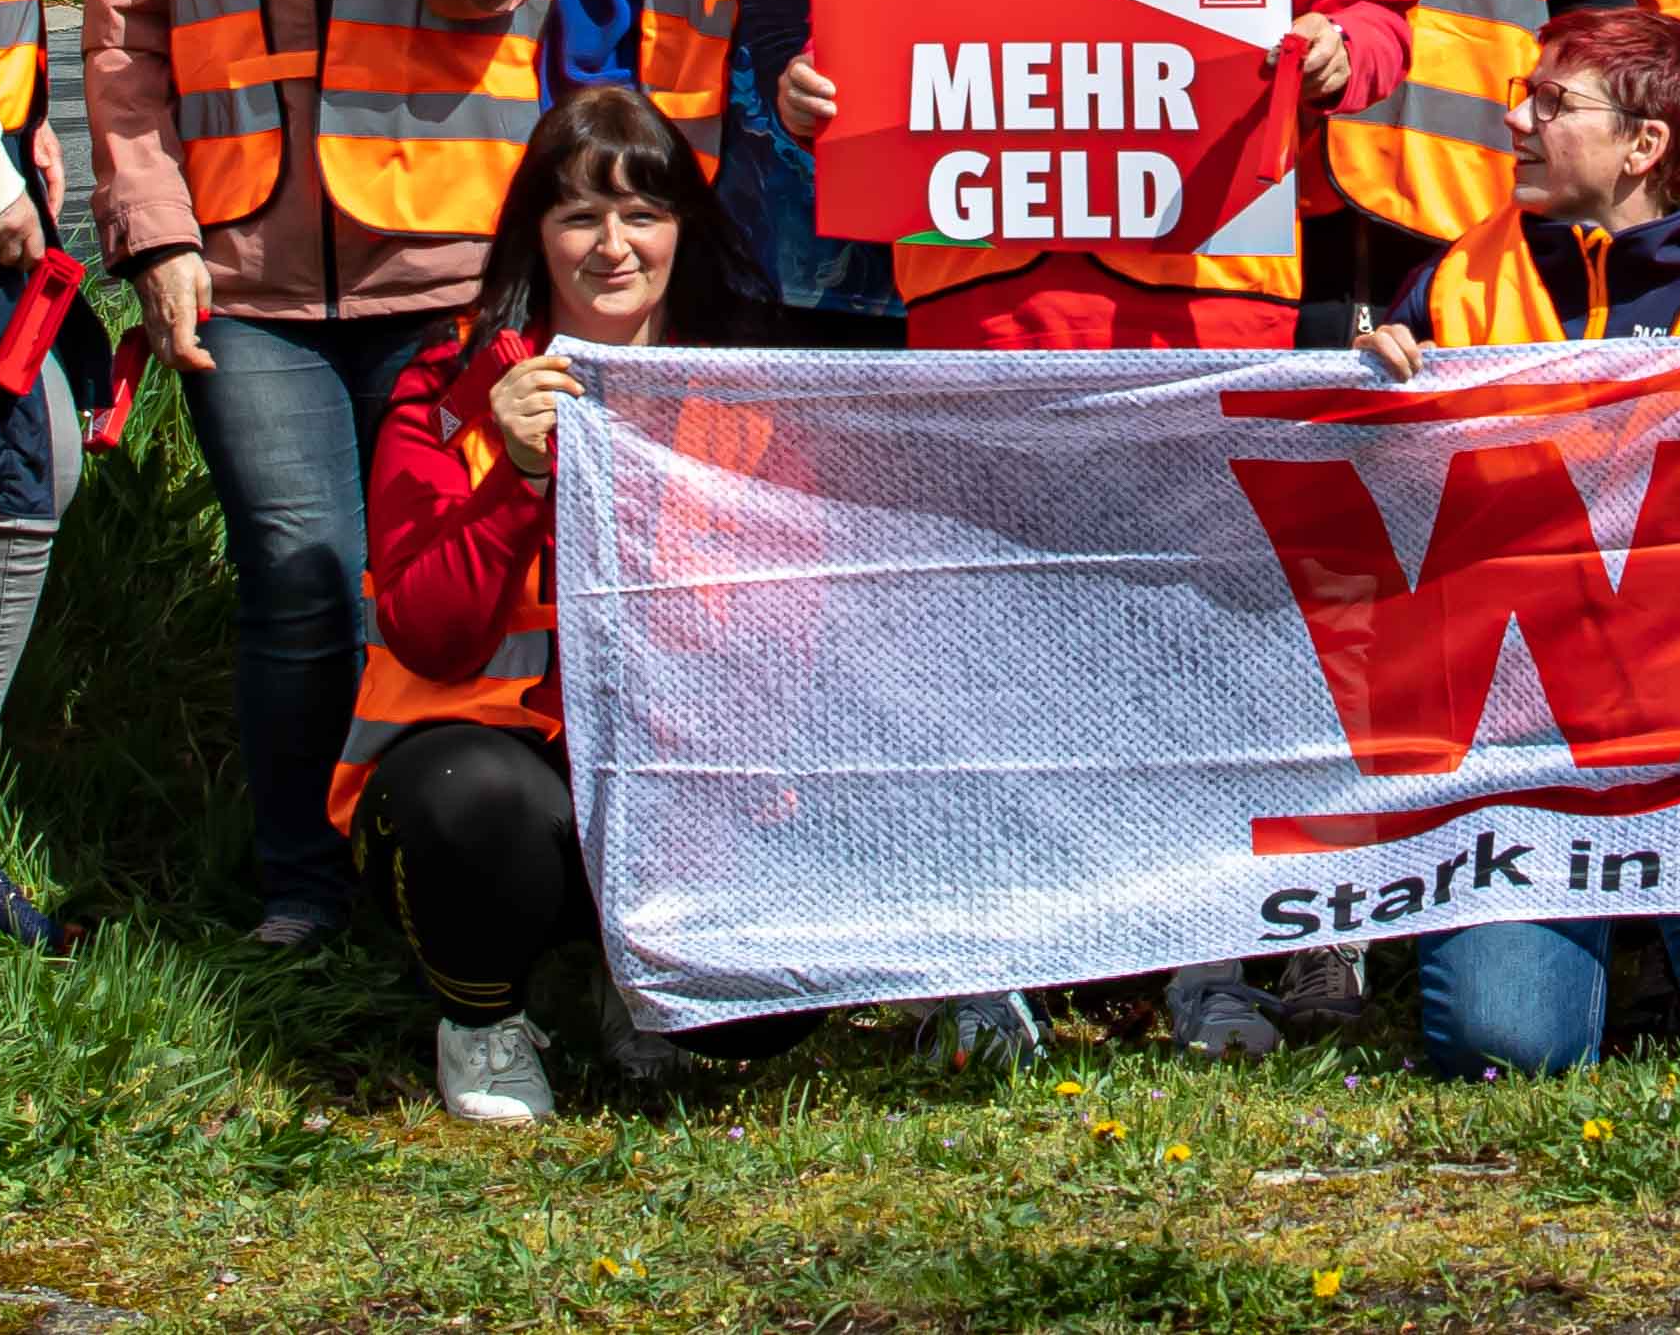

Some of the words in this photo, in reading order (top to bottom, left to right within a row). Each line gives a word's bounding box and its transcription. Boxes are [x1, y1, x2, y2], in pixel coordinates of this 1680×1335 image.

[909, 42, 1199, 132] MEHR
[928, 150, 1183, 241] GELD
[1260, 832, 1532, 940] Stark
[1568, 840, 1661, 892] in
